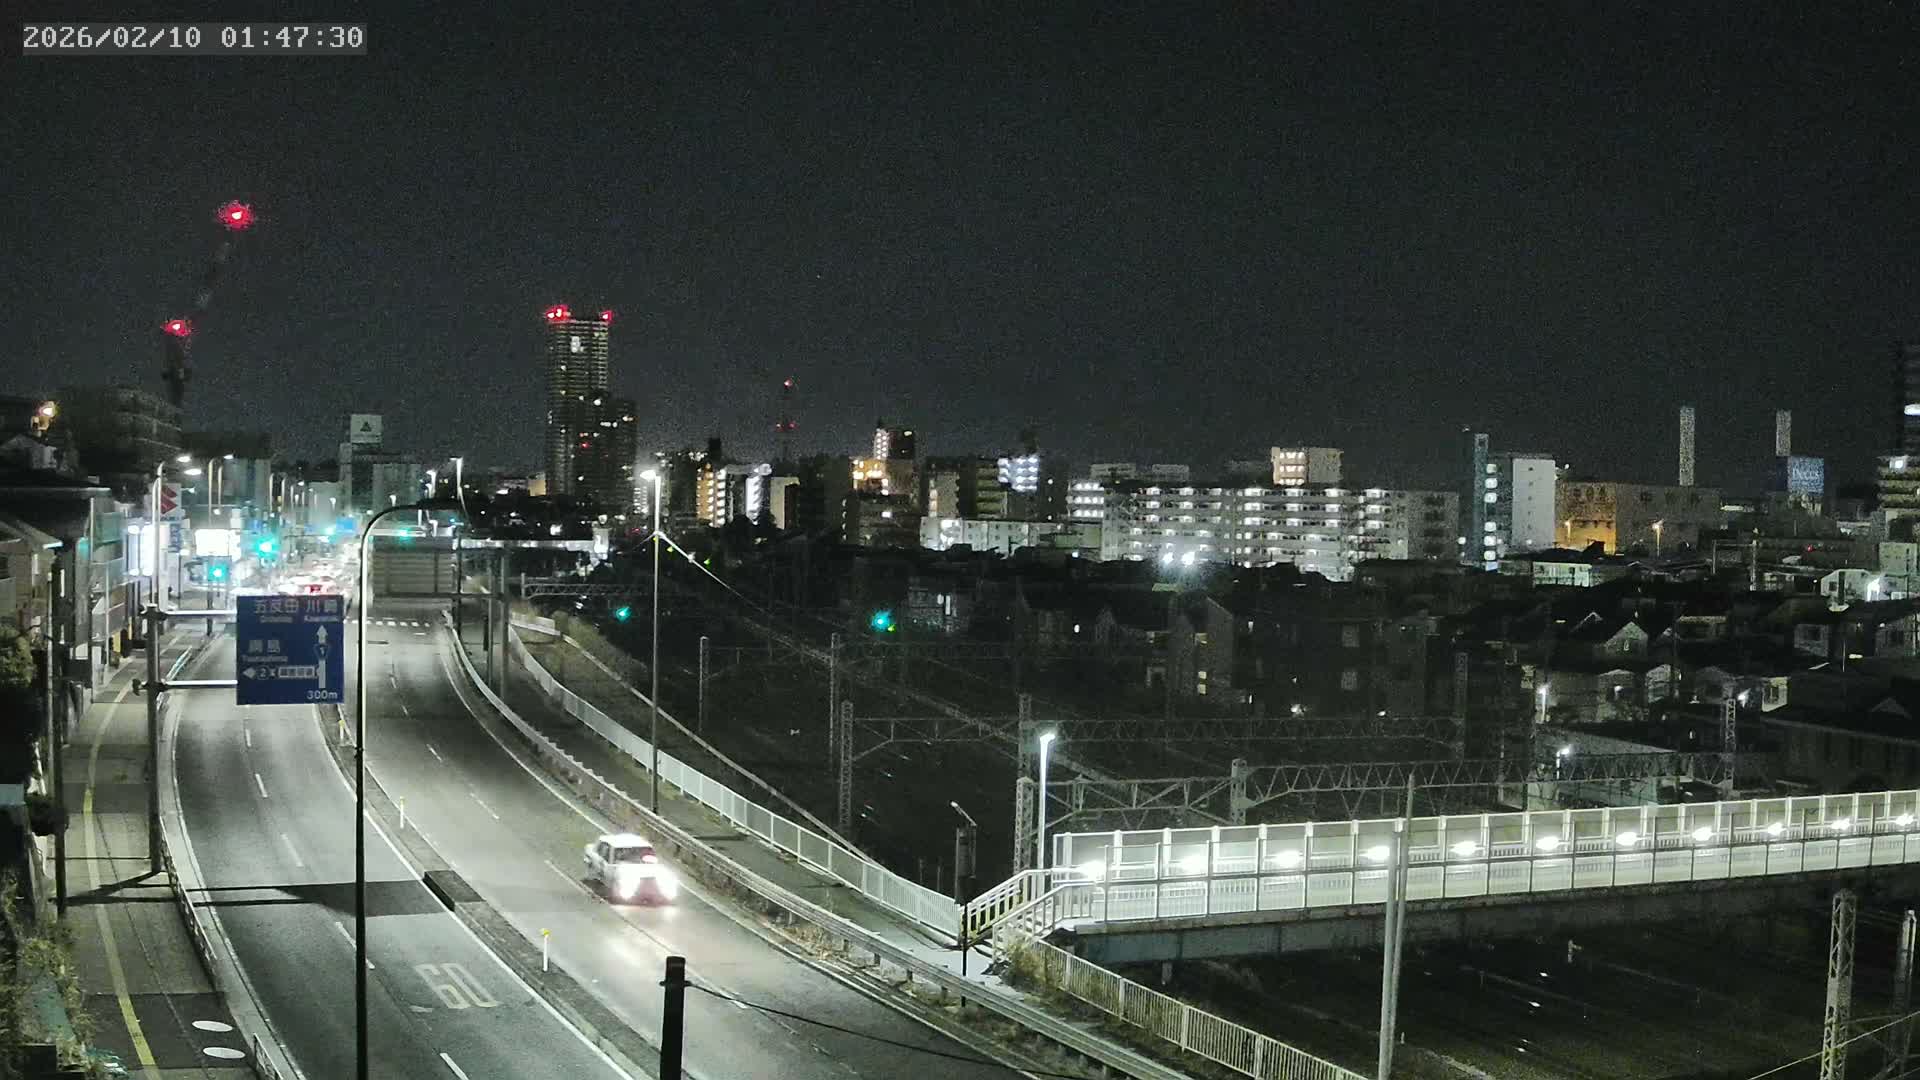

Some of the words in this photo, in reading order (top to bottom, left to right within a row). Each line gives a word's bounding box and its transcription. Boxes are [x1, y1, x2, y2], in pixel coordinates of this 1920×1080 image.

[254, 598, 299, 614] 五反田
[306, 690, 338, 700] 300m
[414, 963, 498, 1009] 60
